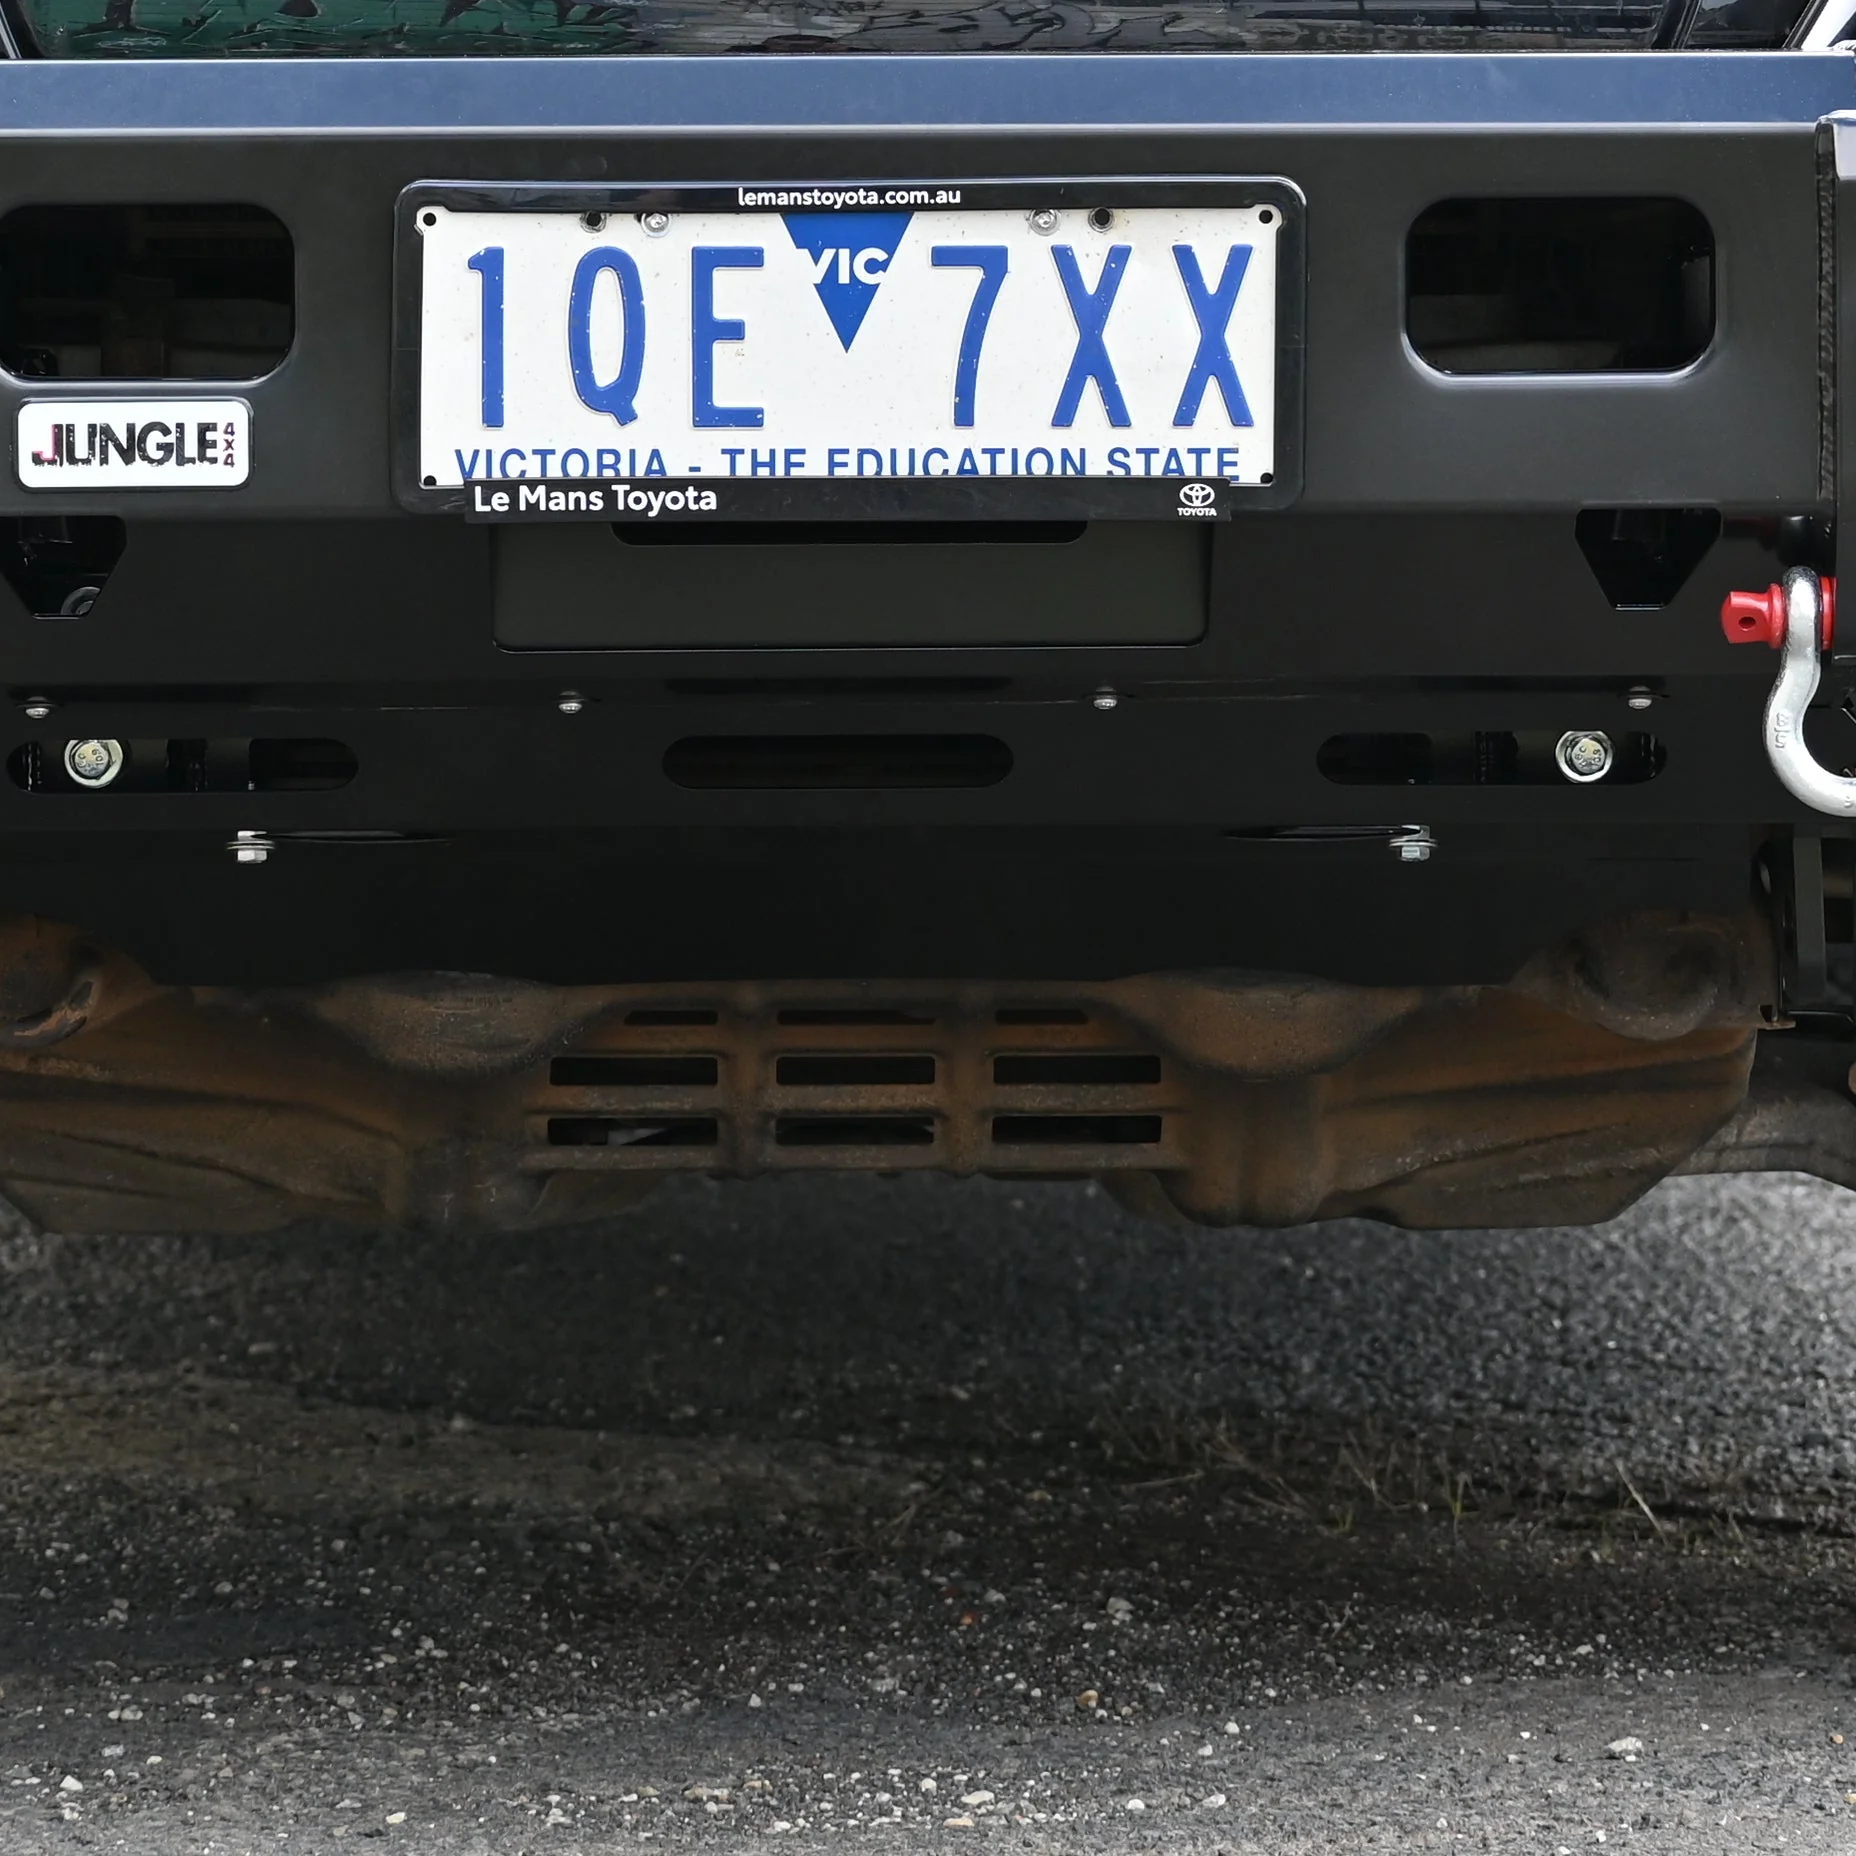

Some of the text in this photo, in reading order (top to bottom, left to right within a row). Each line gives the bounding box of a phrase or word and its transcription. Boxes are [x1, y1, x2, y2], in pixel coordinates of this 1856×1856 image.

[738, 187, 961, 209] lemanstoyota.com.au
[795, 247, 889, 285] VIC
[467, 244, 1254, 428] 1QE 7XX
[31, 421, 219, 467] JUNGLE
[454, 448, 668, 478] VICTORIA
[827, 447, 1086, 476] EDUCATION
[1106, 447, 1240, 482] STATE
[474, 485, 717, 517] Le Mans Toyota
[1177, 507, 1217, 516] TOYOTA
